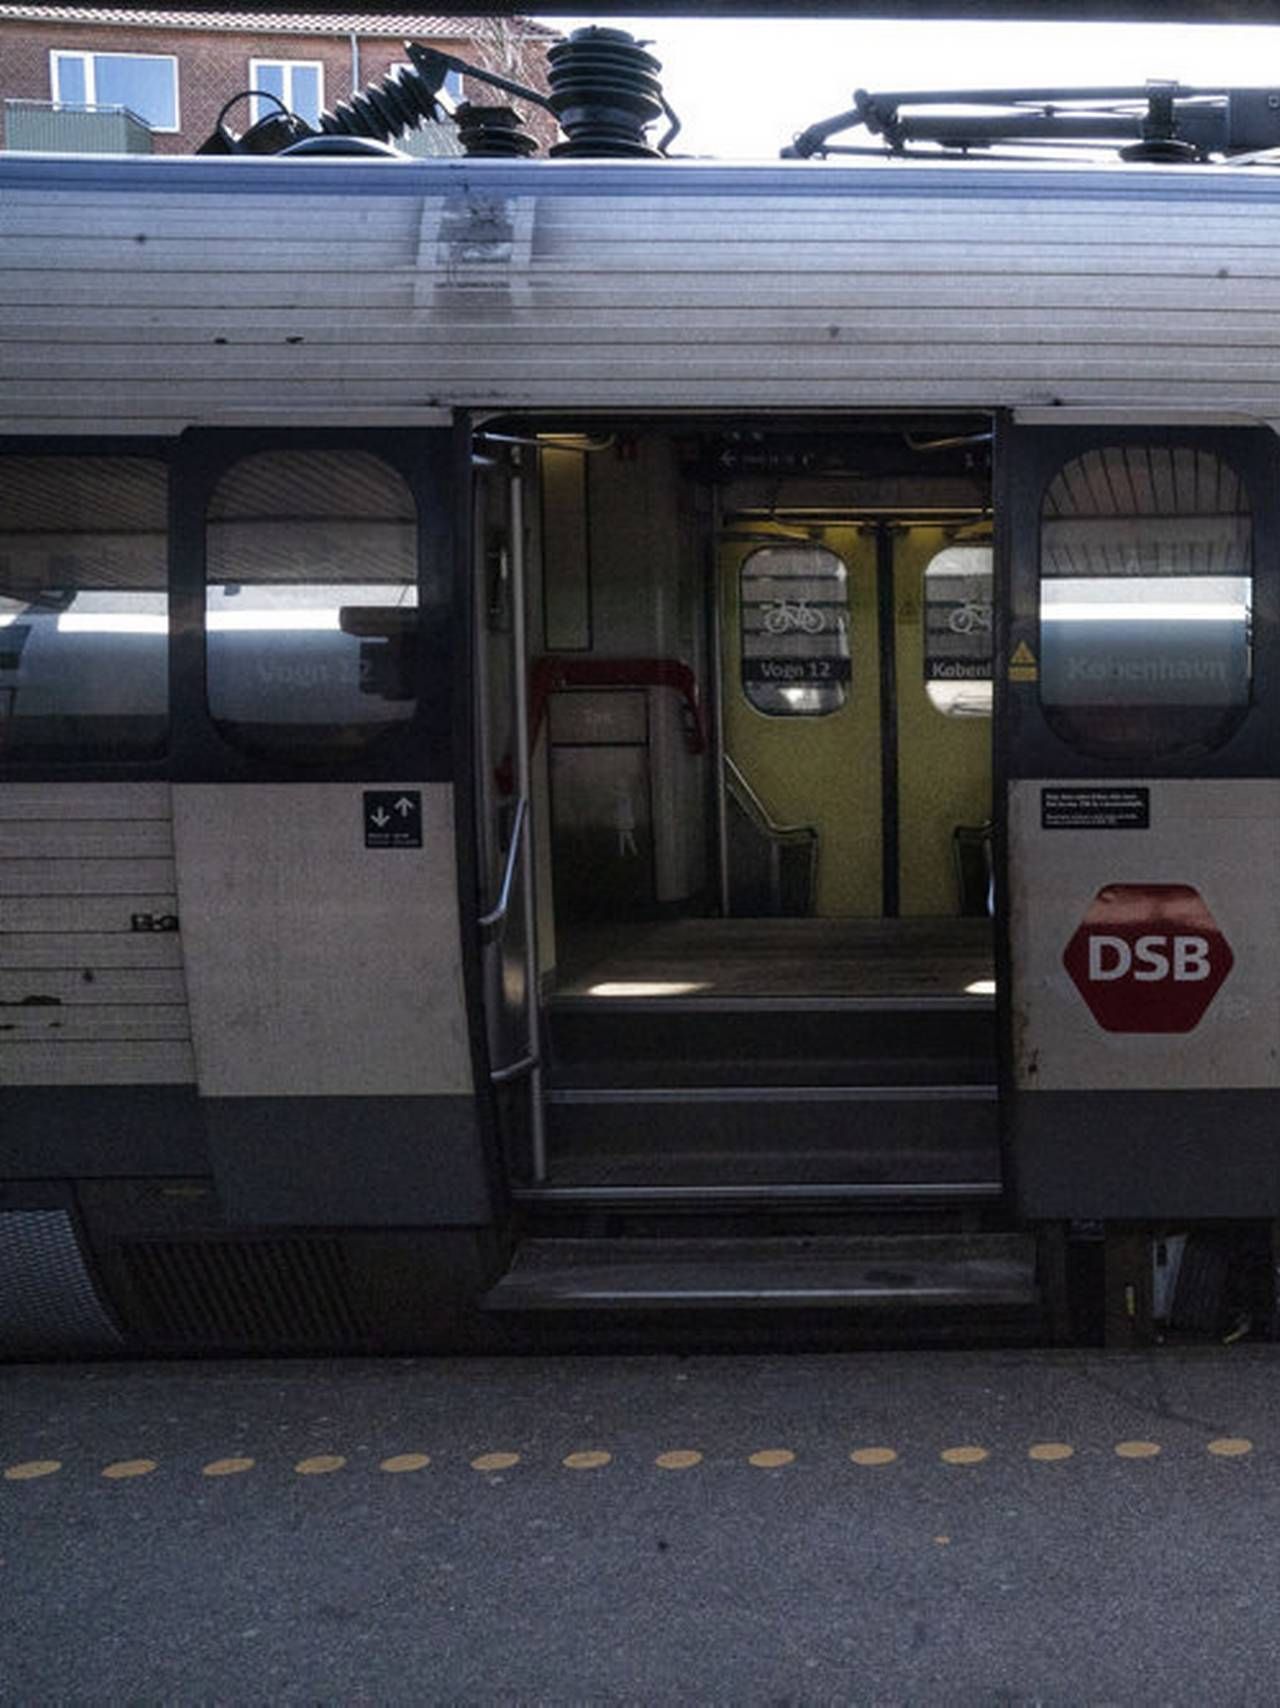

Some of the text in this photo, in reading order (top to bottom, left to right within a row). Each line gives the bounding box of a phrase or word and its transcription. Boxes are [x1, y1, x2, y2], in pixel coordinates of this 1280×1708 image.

[761, 661, 830, 679] Vogn 12
[1088, 935, 1212, 982] DSB
